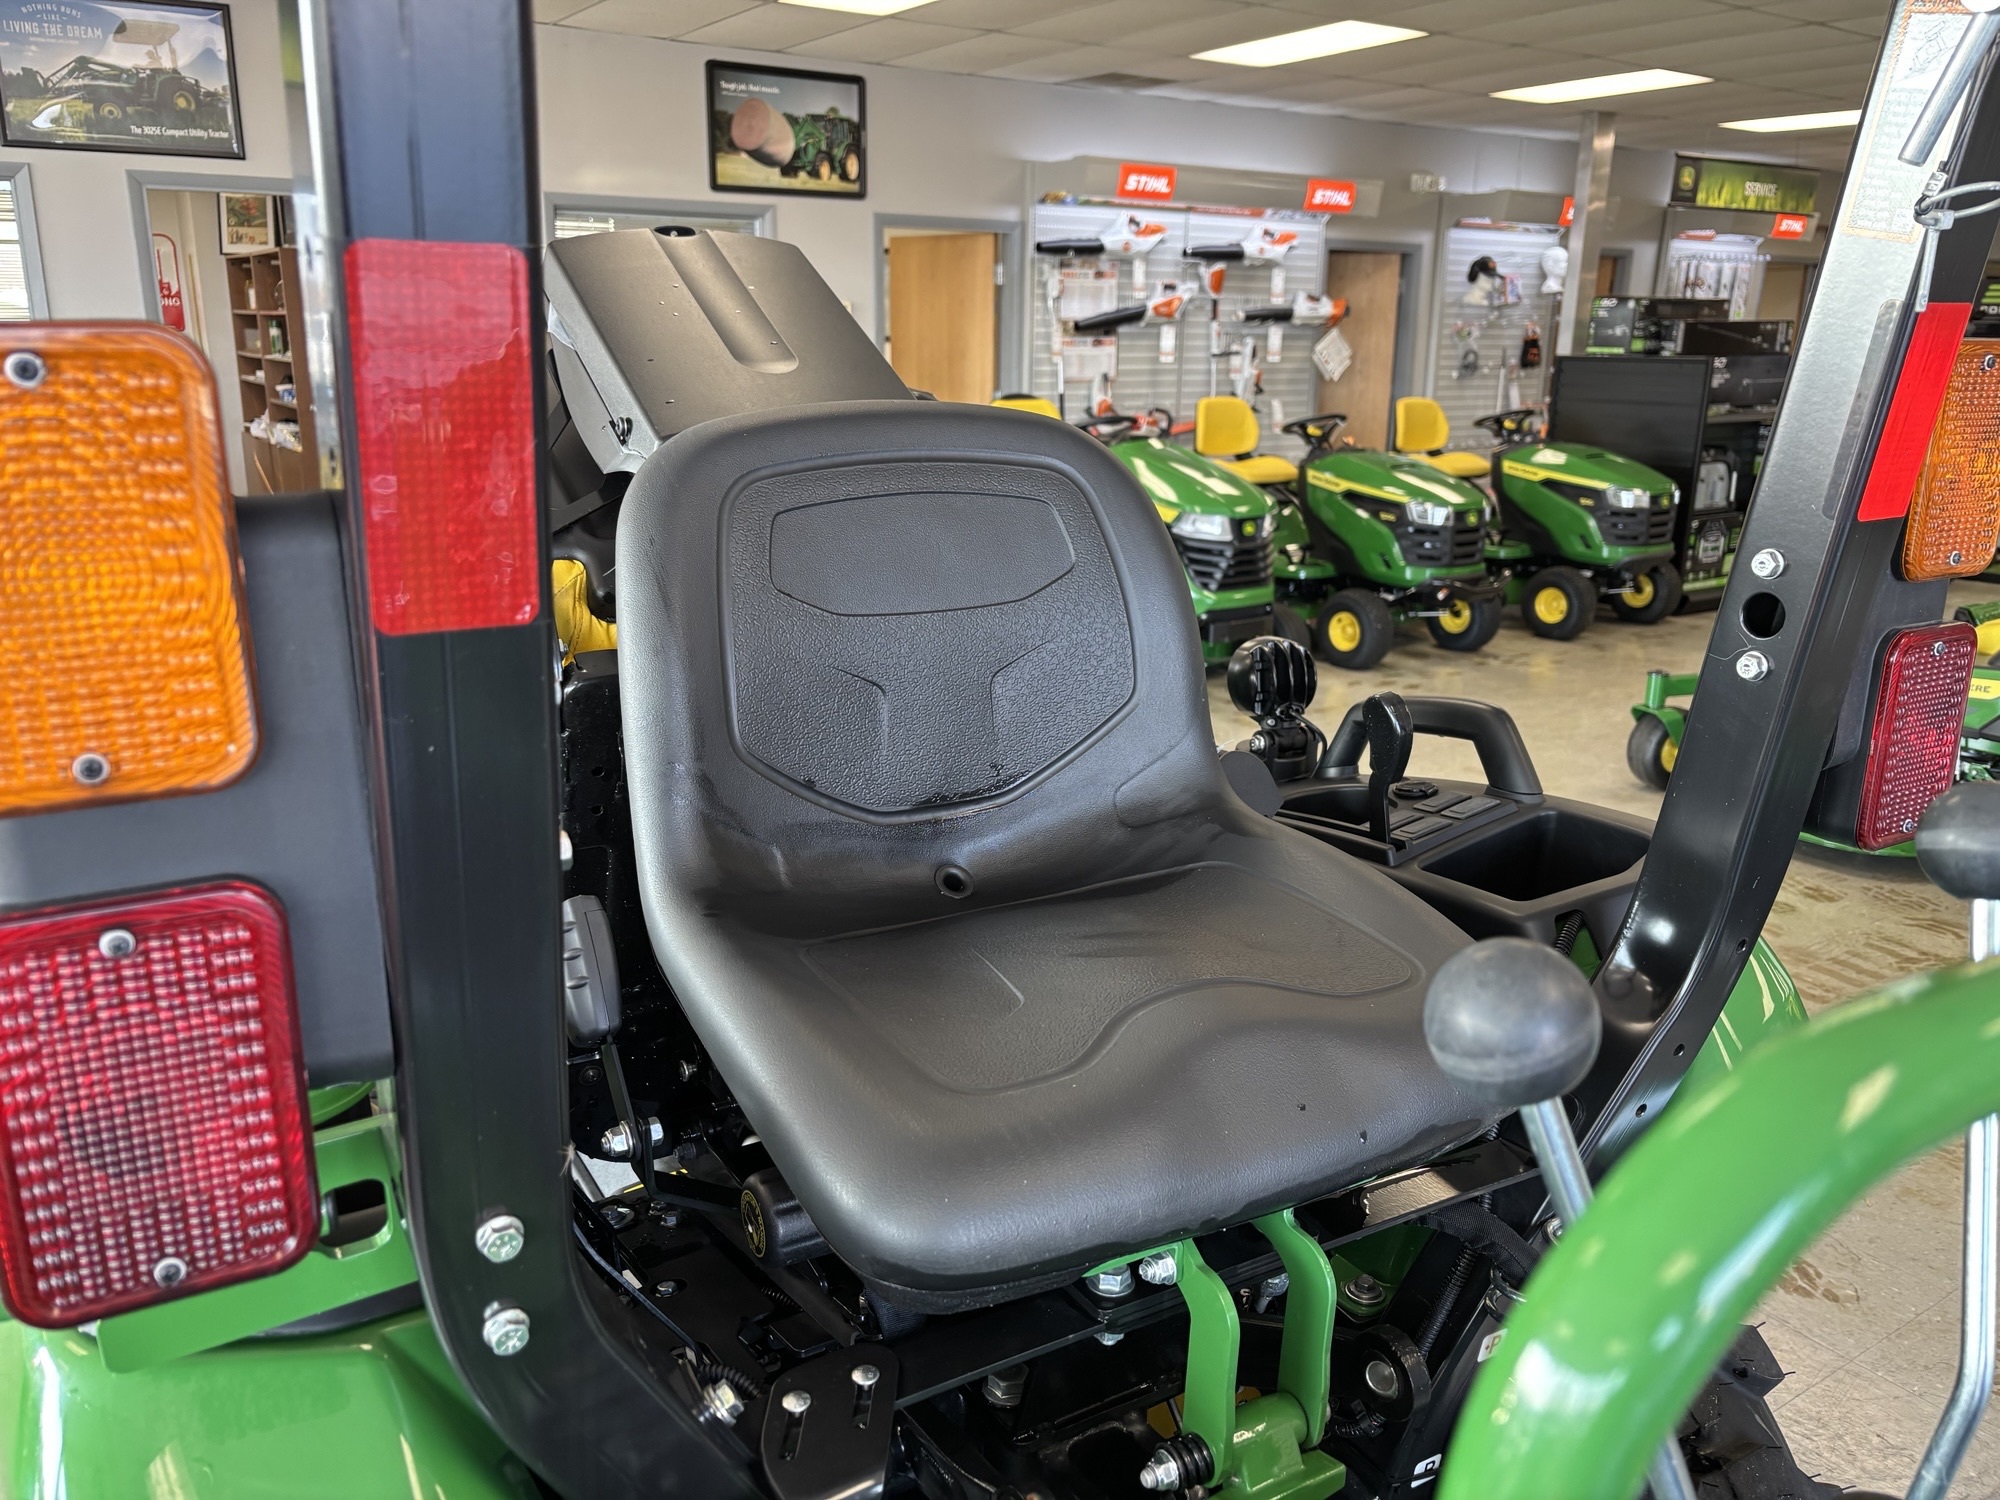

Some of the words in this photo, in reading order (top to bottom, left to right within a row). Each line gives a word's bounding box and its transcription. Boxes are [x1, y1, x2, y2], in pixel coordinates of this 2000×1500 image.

[21, 3, 58, 14] NOTHING
[60, 5, 81, 19] RUNS
[3, 20, 40, 35] LIVING
[42, 23, 64, 37] THE
[66, 25, 103, 40] DREAM
[130, 125, 142, 135] The
[162, 126, 189, 138] Compact
[189, 128, 208, 140] Utility
[208, 128, 230, 139] Tractor
[1124, 173, 1172, 194] STIHL
[1744, 181, 1777, 198] SERVICE
[1312, 188, 1352, 207] STIHL
